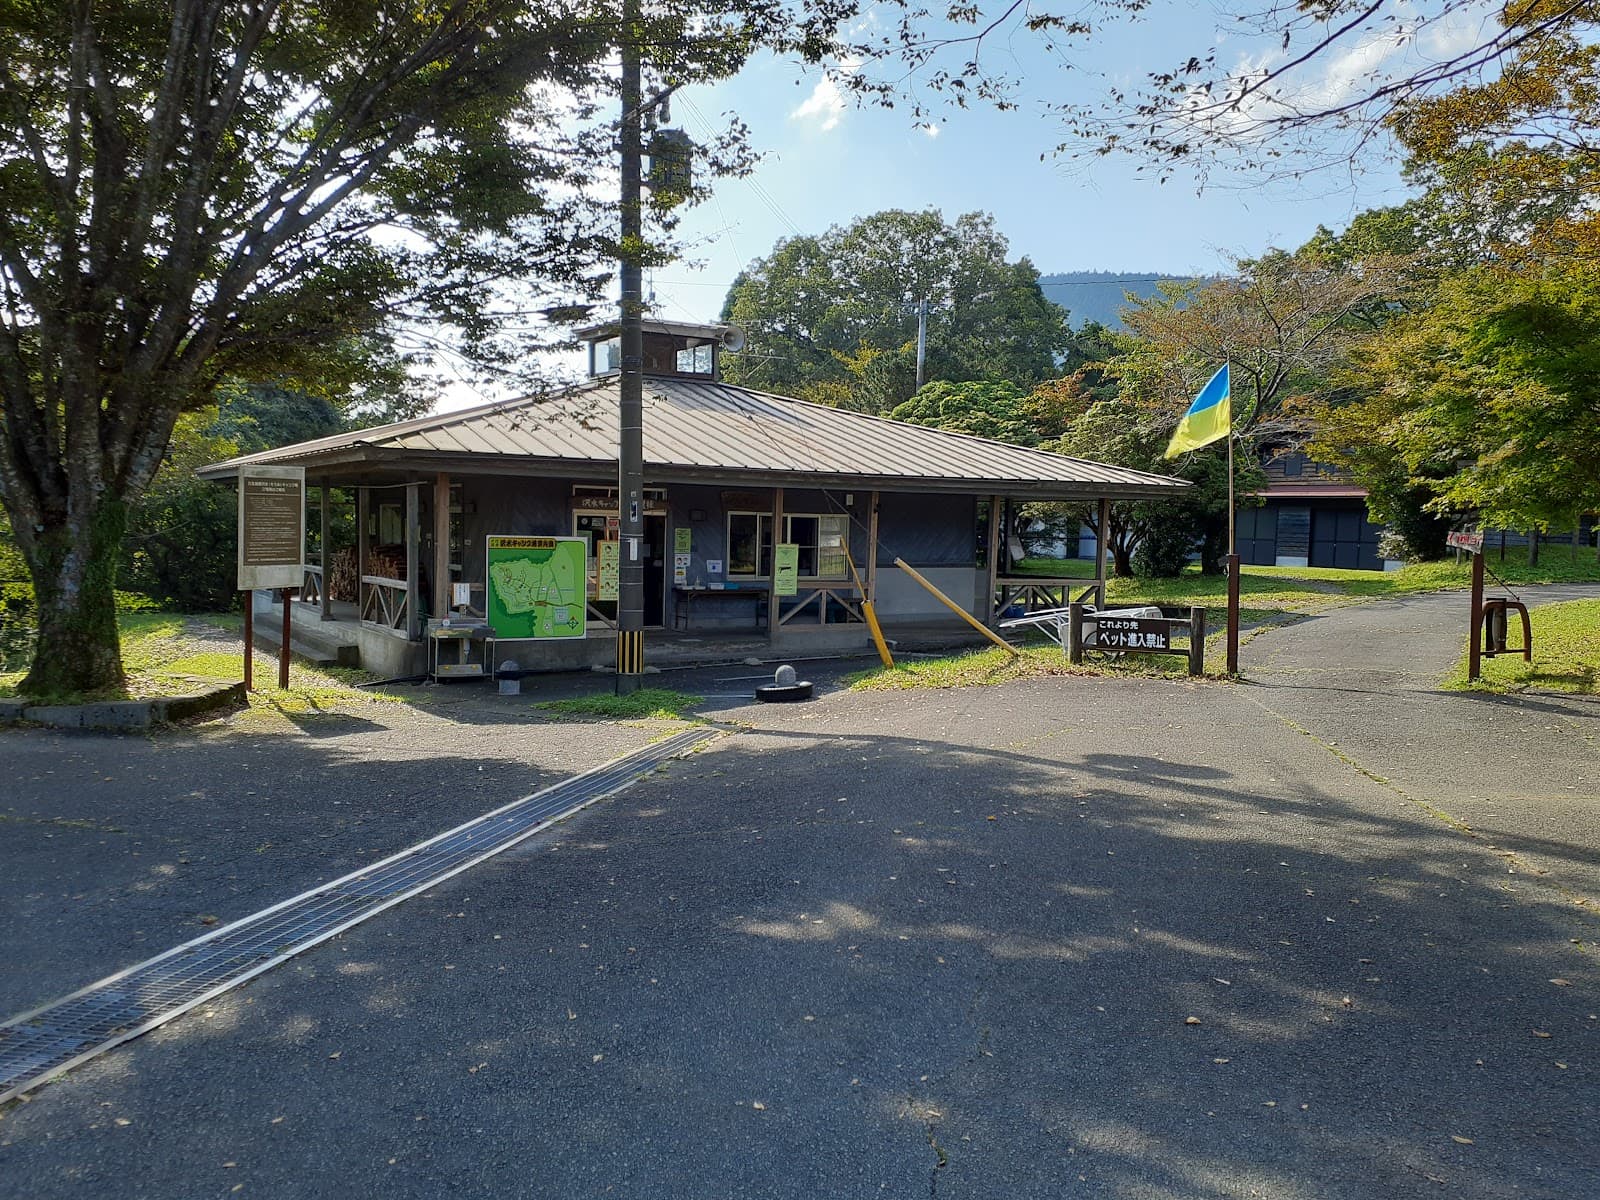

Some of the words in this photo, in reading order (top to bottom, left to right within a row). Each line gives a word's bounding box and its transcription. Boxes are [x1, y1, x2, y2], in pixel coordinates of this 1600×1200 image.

[1099, 620, 1139, 630] これより先
[1100, 632, 1166, 648] ペット進入禁止
